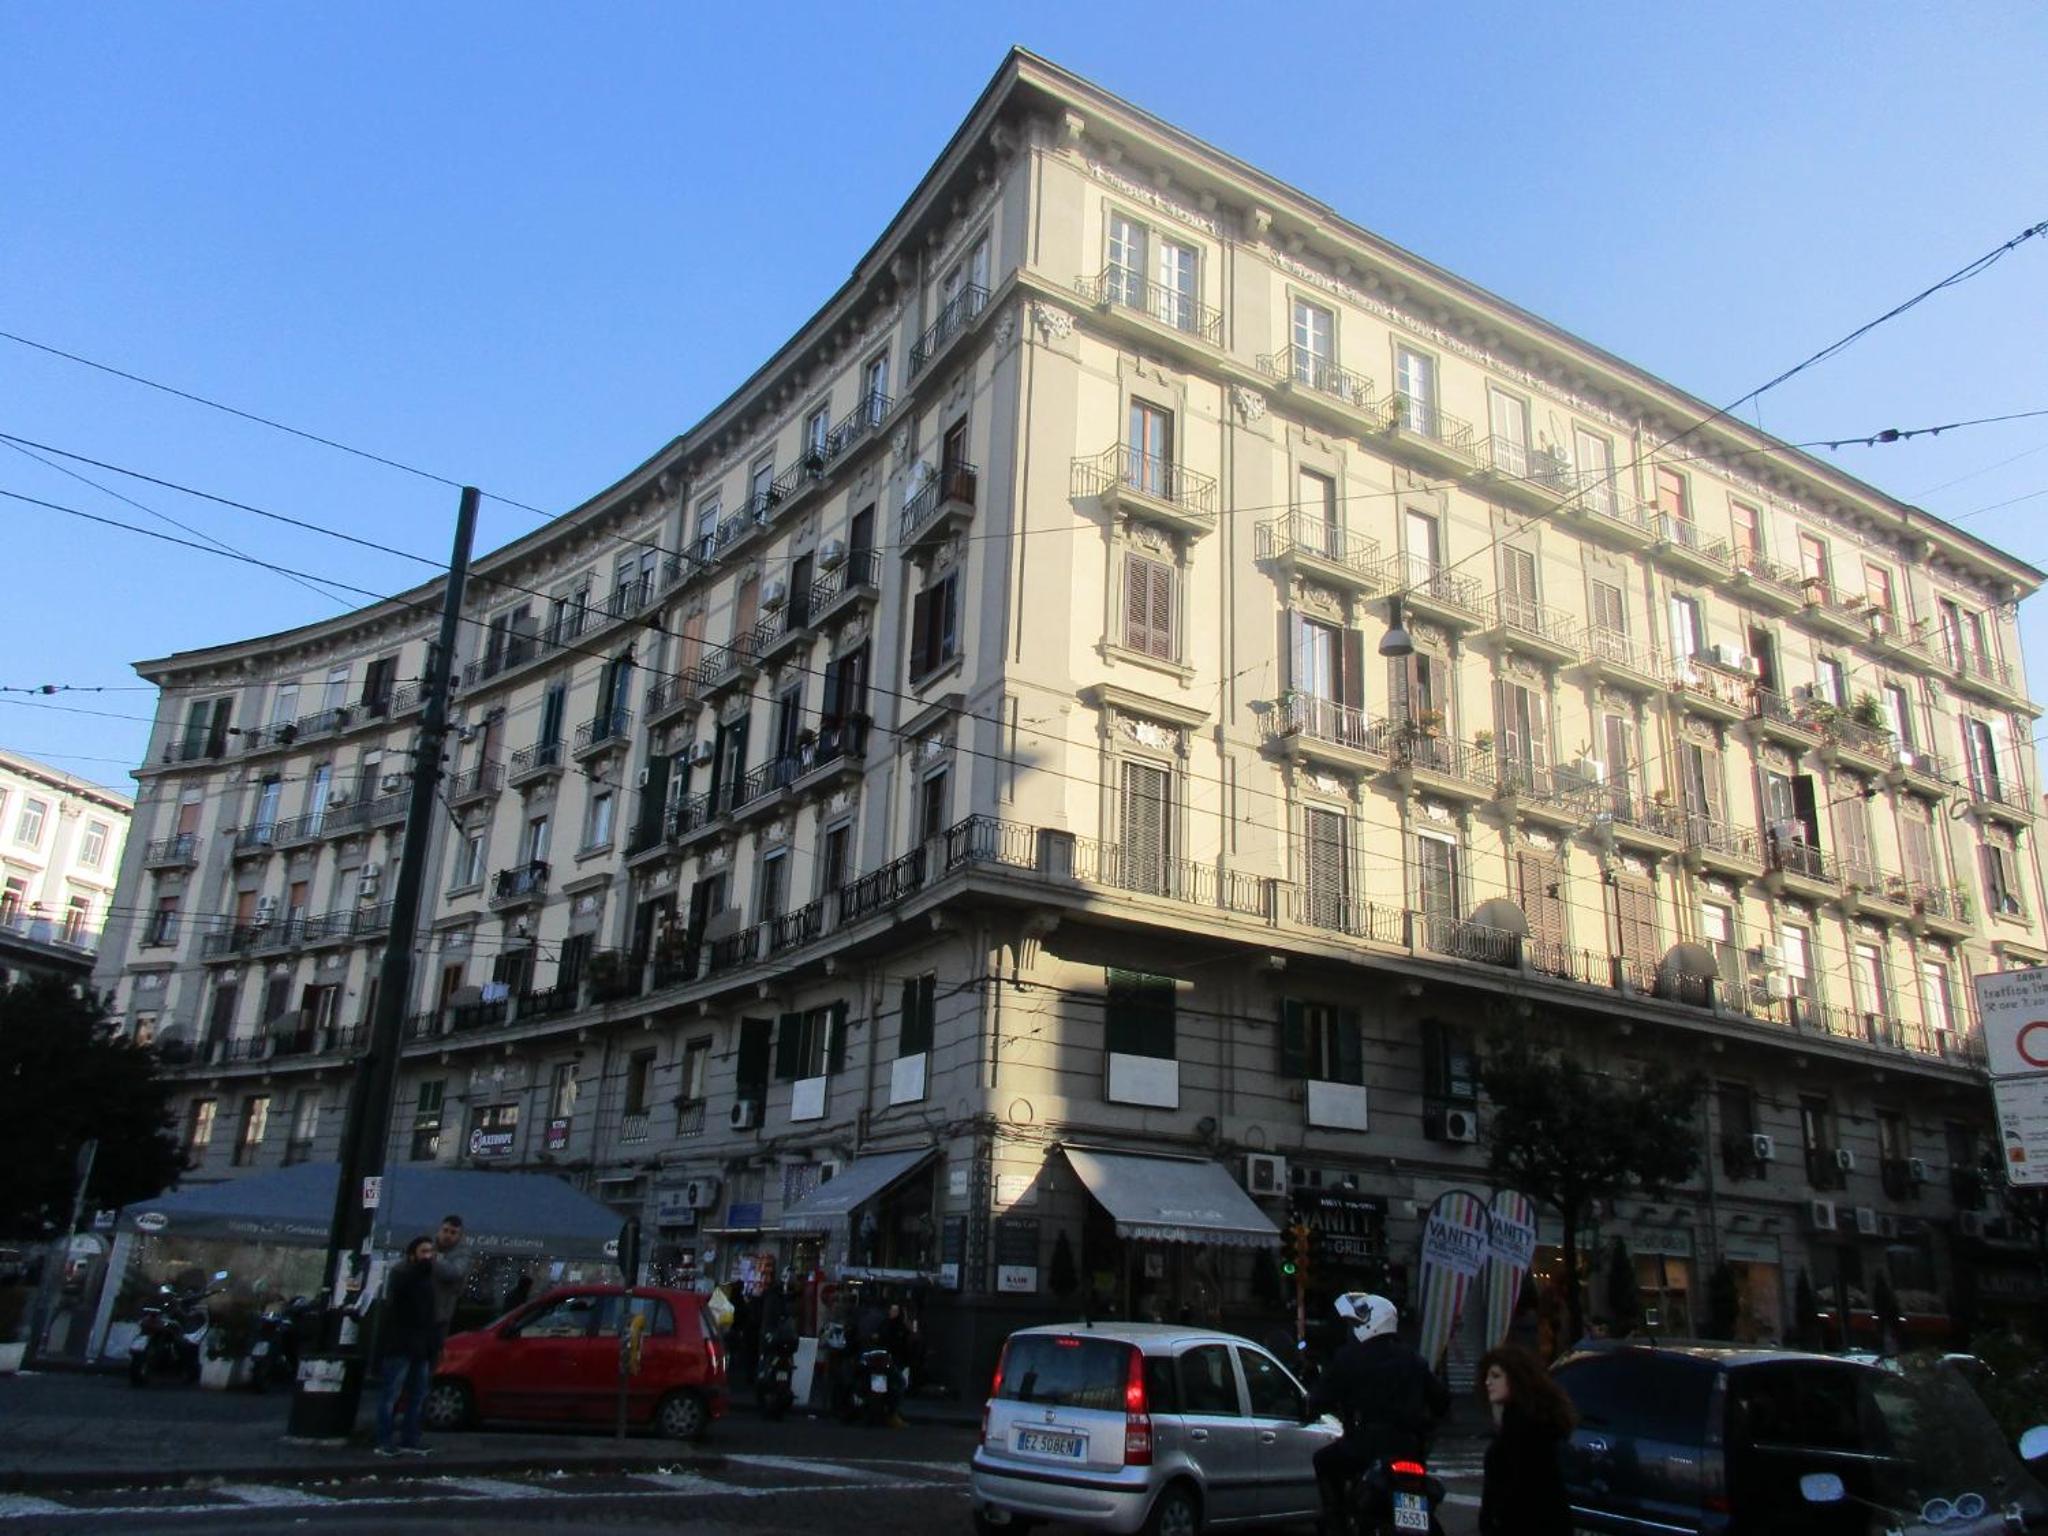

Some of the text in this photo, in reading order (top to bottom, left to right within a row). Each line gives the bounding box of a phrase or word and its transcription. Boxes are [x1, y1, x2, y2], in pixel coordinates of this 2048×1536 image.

[1430, 1220, 1485, 1249] VANITY
[1024, 1434, 1074, 1455] EZ 508EN
